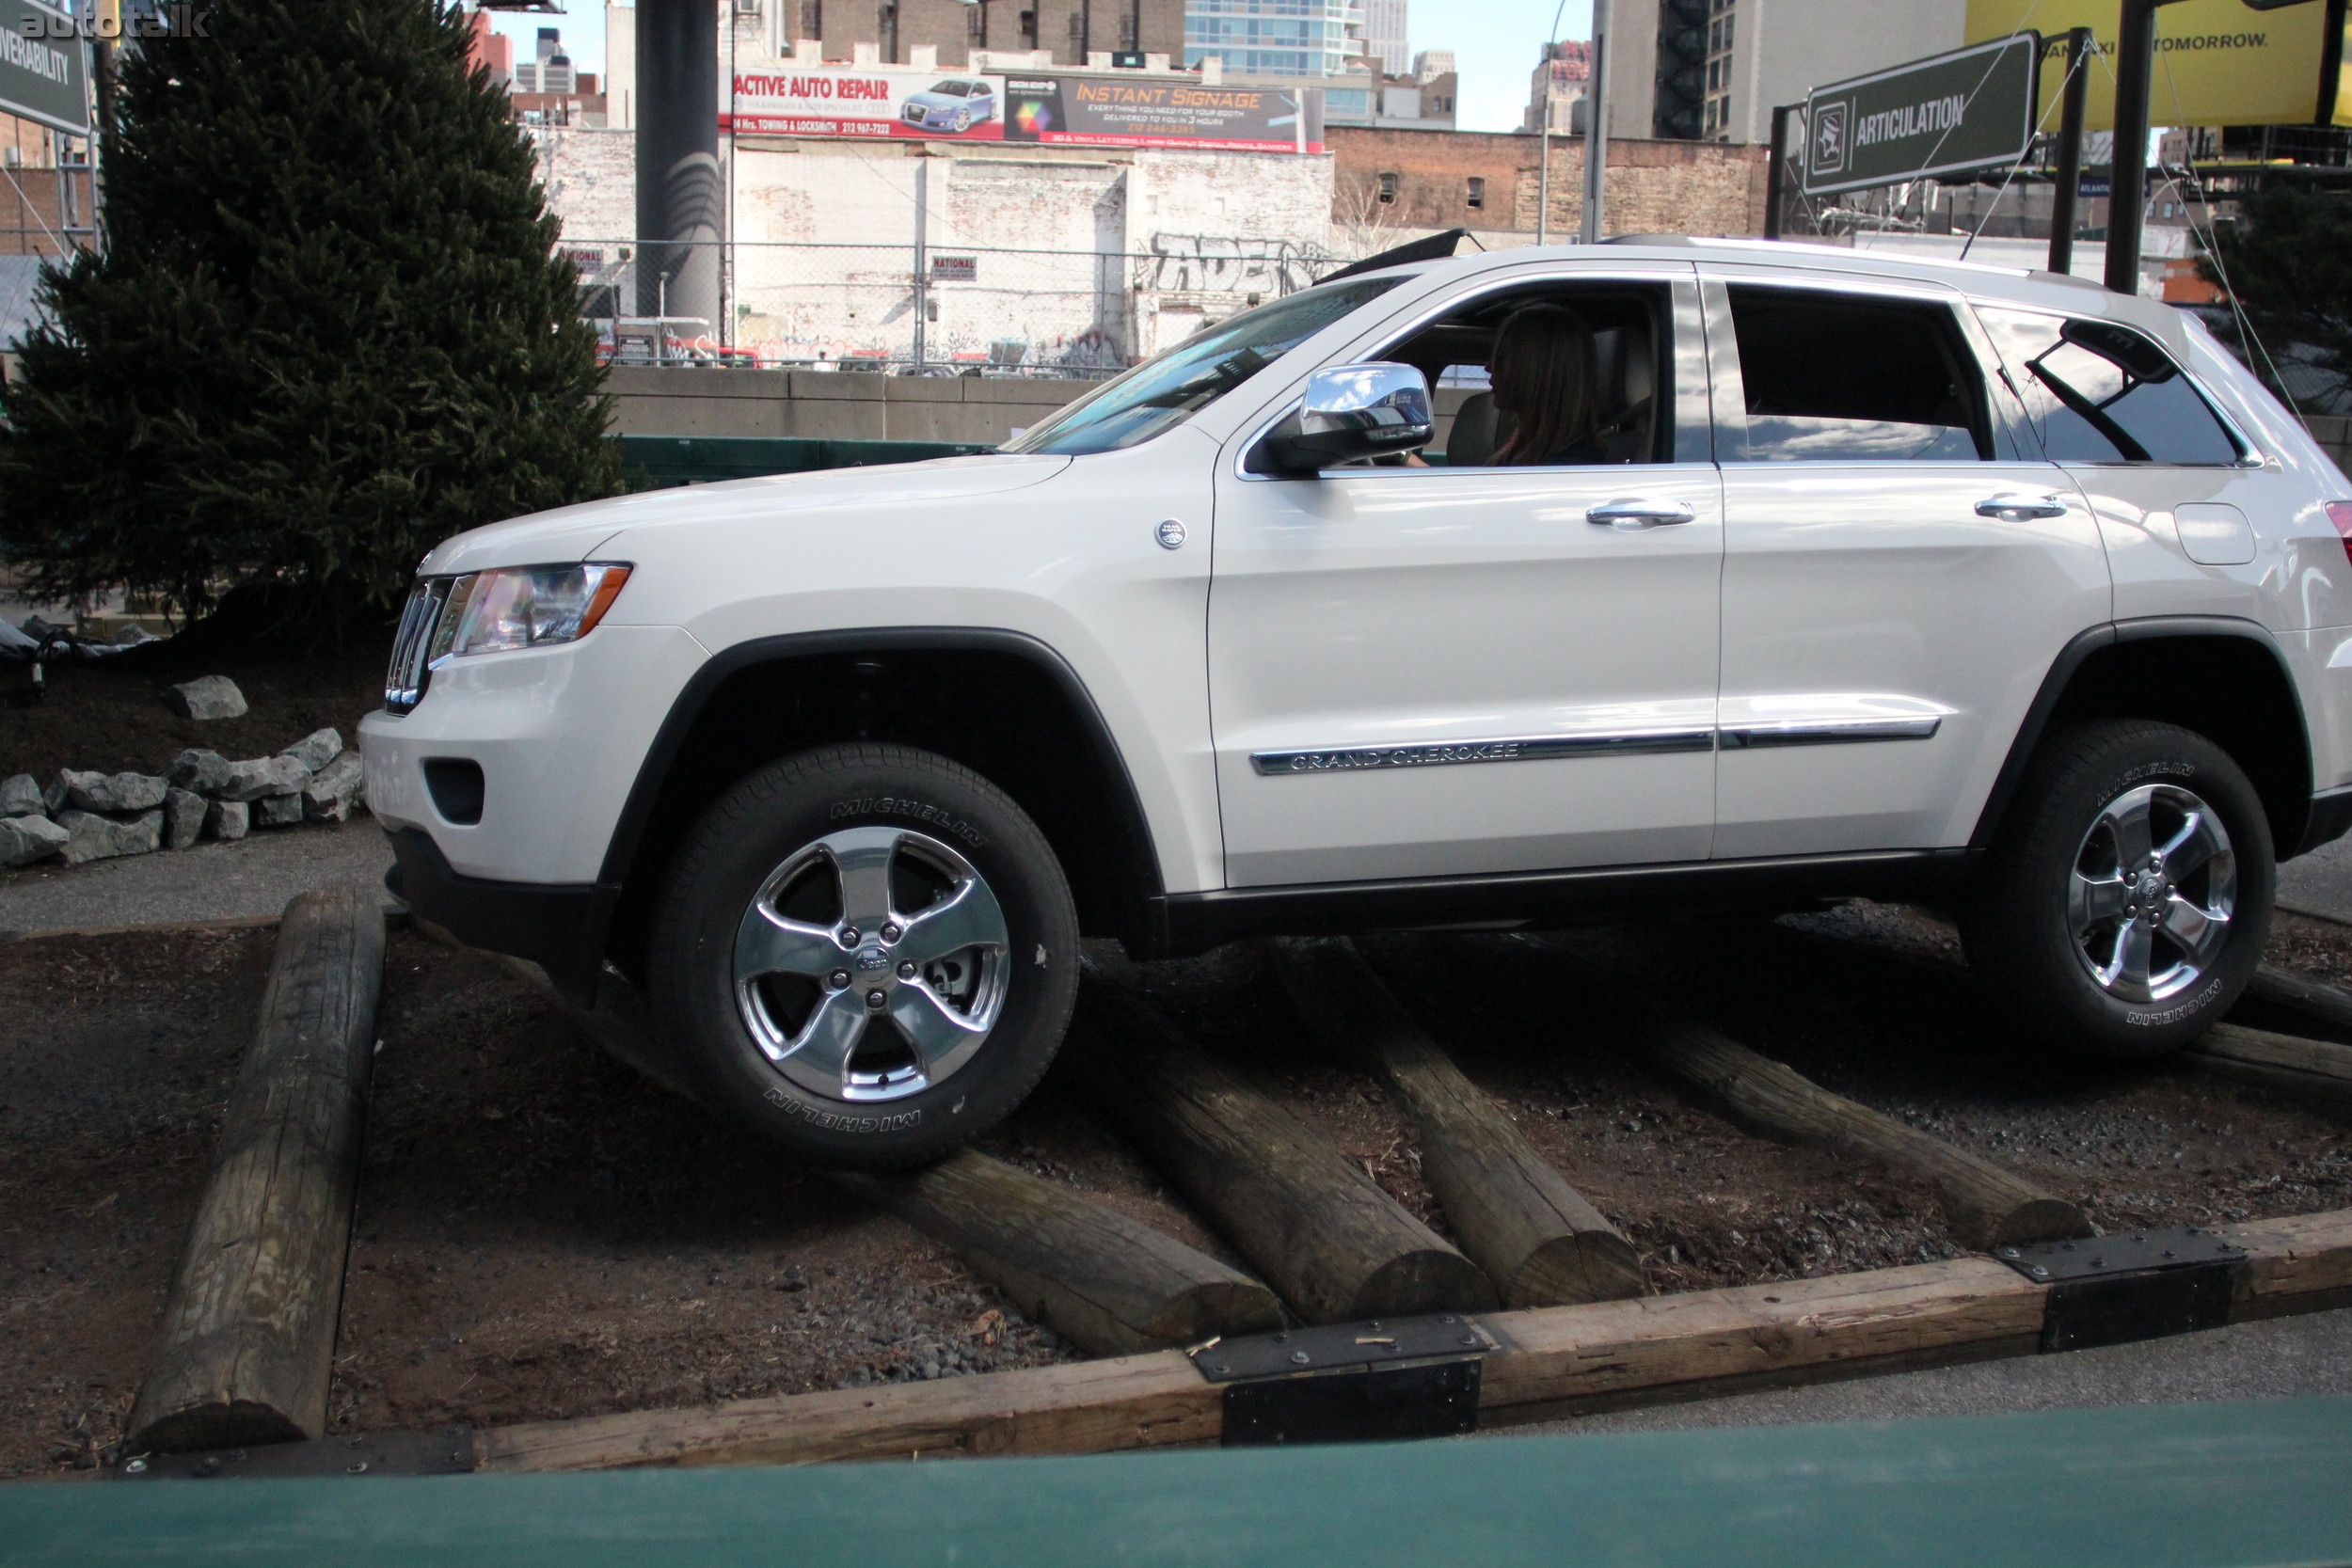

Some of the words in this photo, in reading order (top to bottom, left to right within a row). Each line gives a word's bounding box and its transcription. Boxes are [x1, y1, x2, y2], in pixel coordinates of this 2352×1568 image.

[0, 26, 68, 86] VERABILITY
[734, 74, 785, 95] ACTIVE
[790, 76, 832, 98] AUTO
[837, 79, 888, 100] REPAIR
[1076, 83, 1166, 103] INSTANT
[1170, 88, 1263, 108] SIGNAGE
[758, 119, 787, 130] TOWING
[1188, 116, 1196, 124] 3
[1856, 94, 1963, 147] ARTICULATION
[934, 257, 975, 269] NATIONAL
[1290, 752, 1381, 769] GRAND
[1391, 743, 1519, 764] CHEROKEE
[2097, 761, 2195, 807] MICHELIN
[830, 797, 987, 847] MICHELIN
[2126, 978, 2223, 1025] MICHELIN
[763, 1086, 921, 1133] MICHELIN
